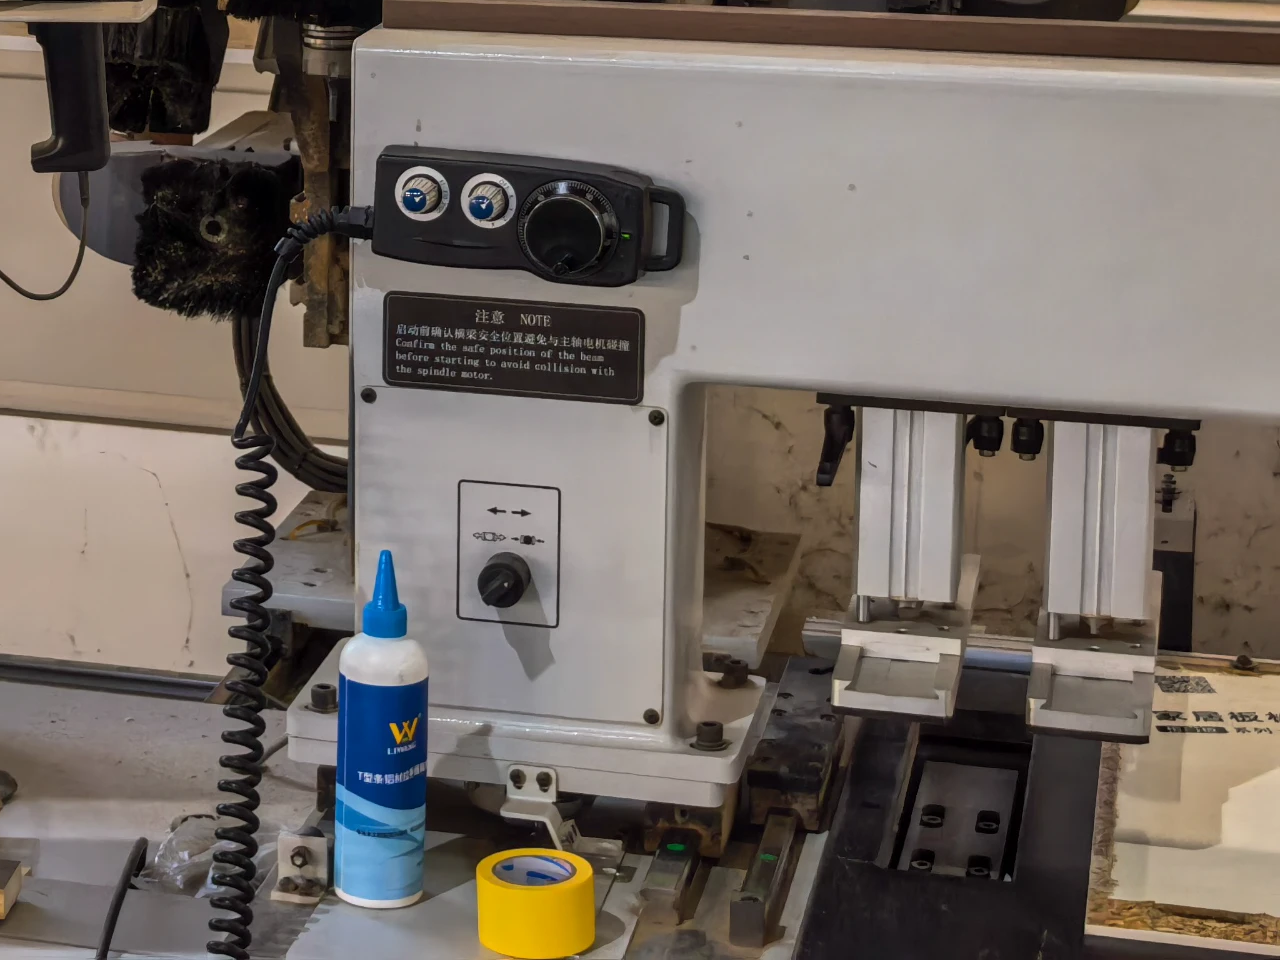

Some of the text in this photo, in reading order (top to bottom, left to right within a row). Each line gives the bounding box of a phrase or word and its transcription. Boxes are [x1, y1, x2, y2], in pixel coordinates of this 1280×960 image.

[475, 309, 551, 327] 注意 NOTE
[396, 338, 604, 362] Confirm the safe position of the beam
[396, 352, 615, 376] before starting to avoid collision with
[396, 365, 493, 380] the spindle motor.
